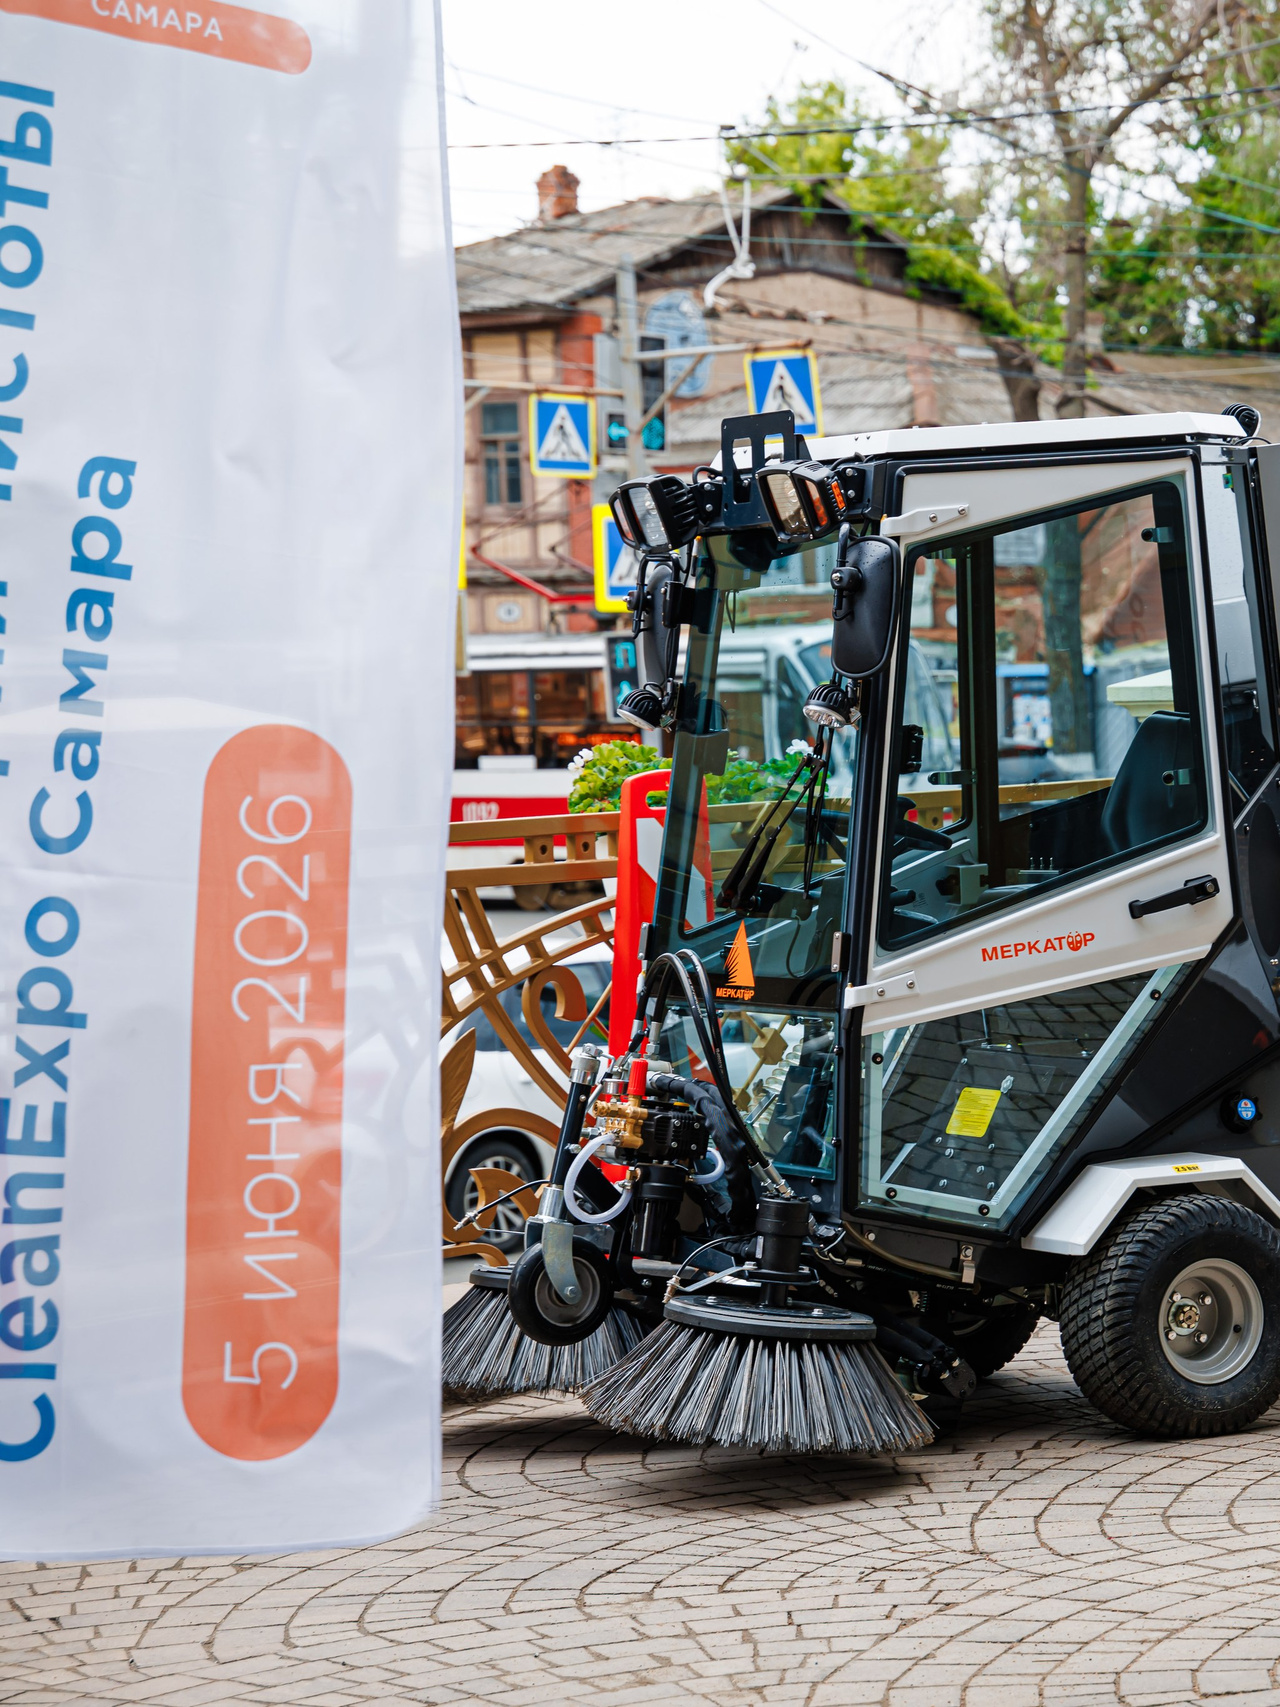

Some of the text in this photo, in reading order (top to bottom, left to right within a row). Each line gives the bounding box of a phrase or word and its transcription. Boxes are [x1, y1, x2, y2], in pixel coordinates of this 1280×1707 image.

[92, 0, 224, 41] САМАРА
[0, 455, 138, 1462] CleanExpo Самара
[981, 931, 1095, 962] МЕРКАТОР
[715, 987, 755, 1001] МЕРКАТОР
[223, 795, 313, 1390] 5 июня 2026
